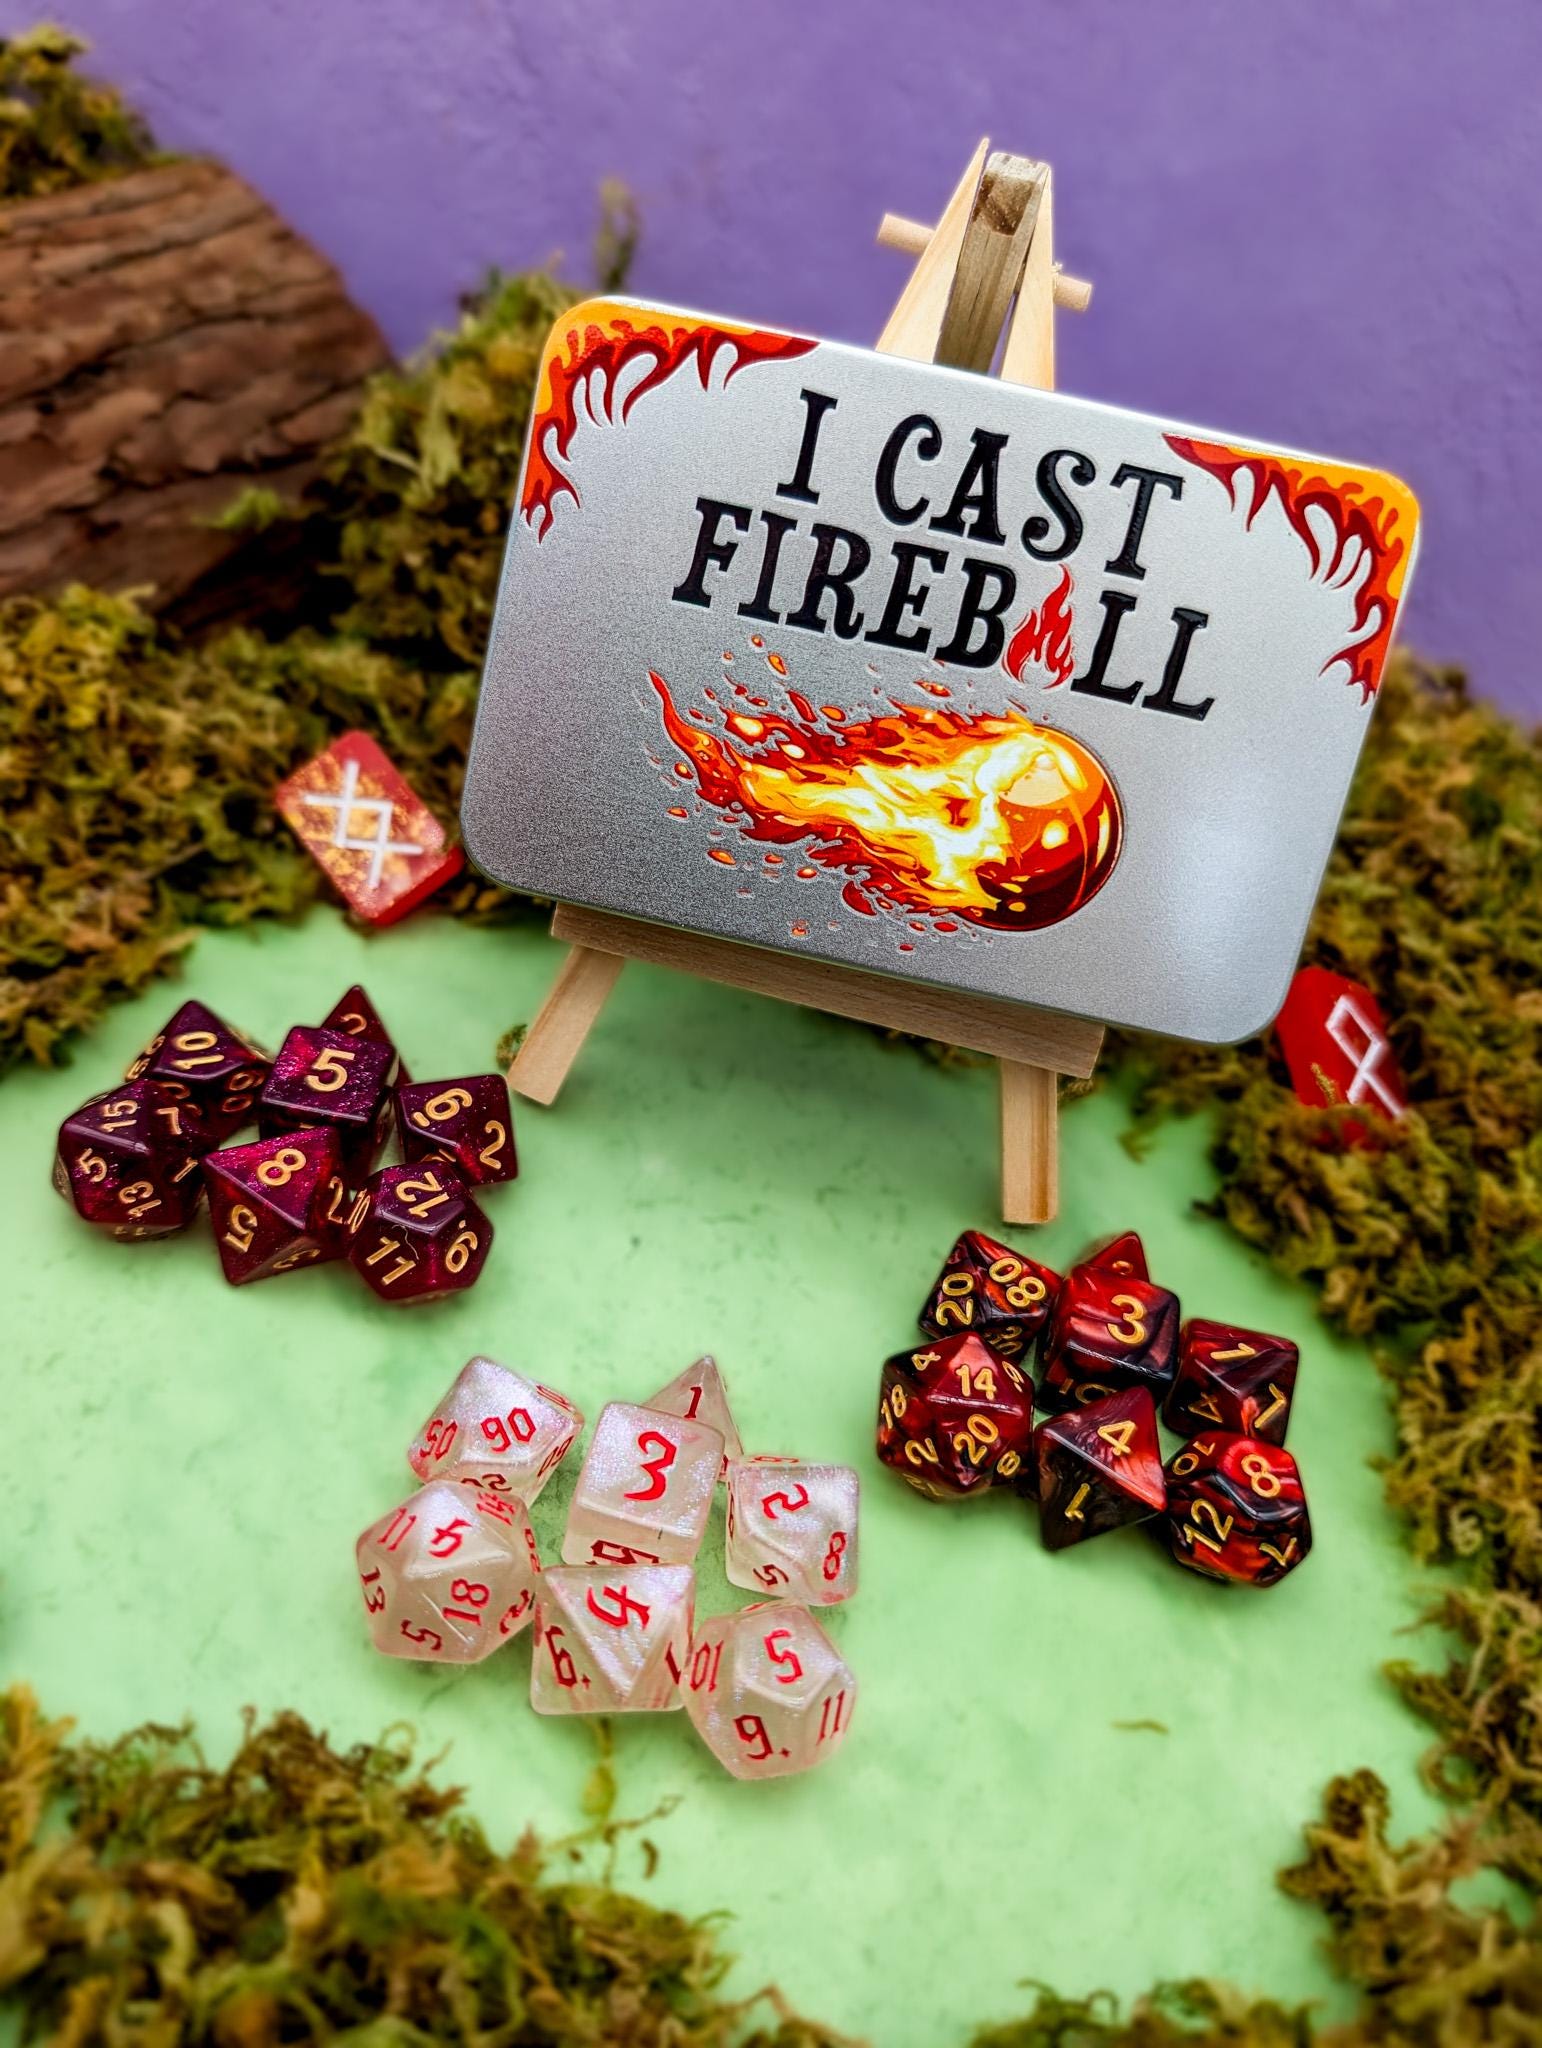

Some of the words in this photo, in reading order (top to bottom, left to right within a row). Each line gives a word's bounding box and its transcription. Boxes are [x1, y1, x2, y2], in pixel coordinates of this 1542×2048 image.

[776, 389, 837, 503] I
[876, 414, 1184, 579] CAST
[172, 1031, 224, 1070] 10
[305, 1048, 355, 1092] 5
[102, 1100, 137, 1132] 15
[156, 1107, 181, 1135] 7
[80, 1148, 107, 1182] 5
[479, 1120, 506, 1169] 2
[257, 1149, 306, 1186] 8
[120, 1181, 161, 1217] 13
[327, 1176, 343, 1224] 2
[396, 1171, 449, 1218] 12
[224, 1205, 257, 1252] 5
[366, 1237, 416, 1285] 11
[989, 1257, 1046, 1307] 80
[935, 1273, 974, 1325] 20
[1107, 1295, 1146, 1345] 3
[912, 1352, 941, 1371] 4
[1210, 1342, 1256, 1360] 1
[684, 1387, 702, 1418] 1
[956, 1364, 996, 1400] 14
[881, 1384, 907, 1429] 18
[1187, 1391, 1224, 1423] 4
[420, 1419, 458, 1460] 50
[481, 1407, 537, 1452] 90
[905, 1438, 938, 1465] 2
[953, 1414, 999, 1465] 20
[1098, 1420, 1136, 1456] 4
[623, 1431, 676, 1501] 3
[997, 1450, 1021, 1476] 8
[1172, 1441, 1216, 1476] 10
[1242, 1454, 1281, 1498] 8
[1065, 1483, 1090, 1521] 1
[378, 1508, 416, 1551] 11
[1183, 1499, 1234, 1553] 12
[823, 1531, 847, 1580] 8
[362, 1567, 386, 1614] 13
[442, 1579, 490, 1626] 18
[764, 1629, 803, 1684] 5
[817, 1690, 844, 1746] 11
